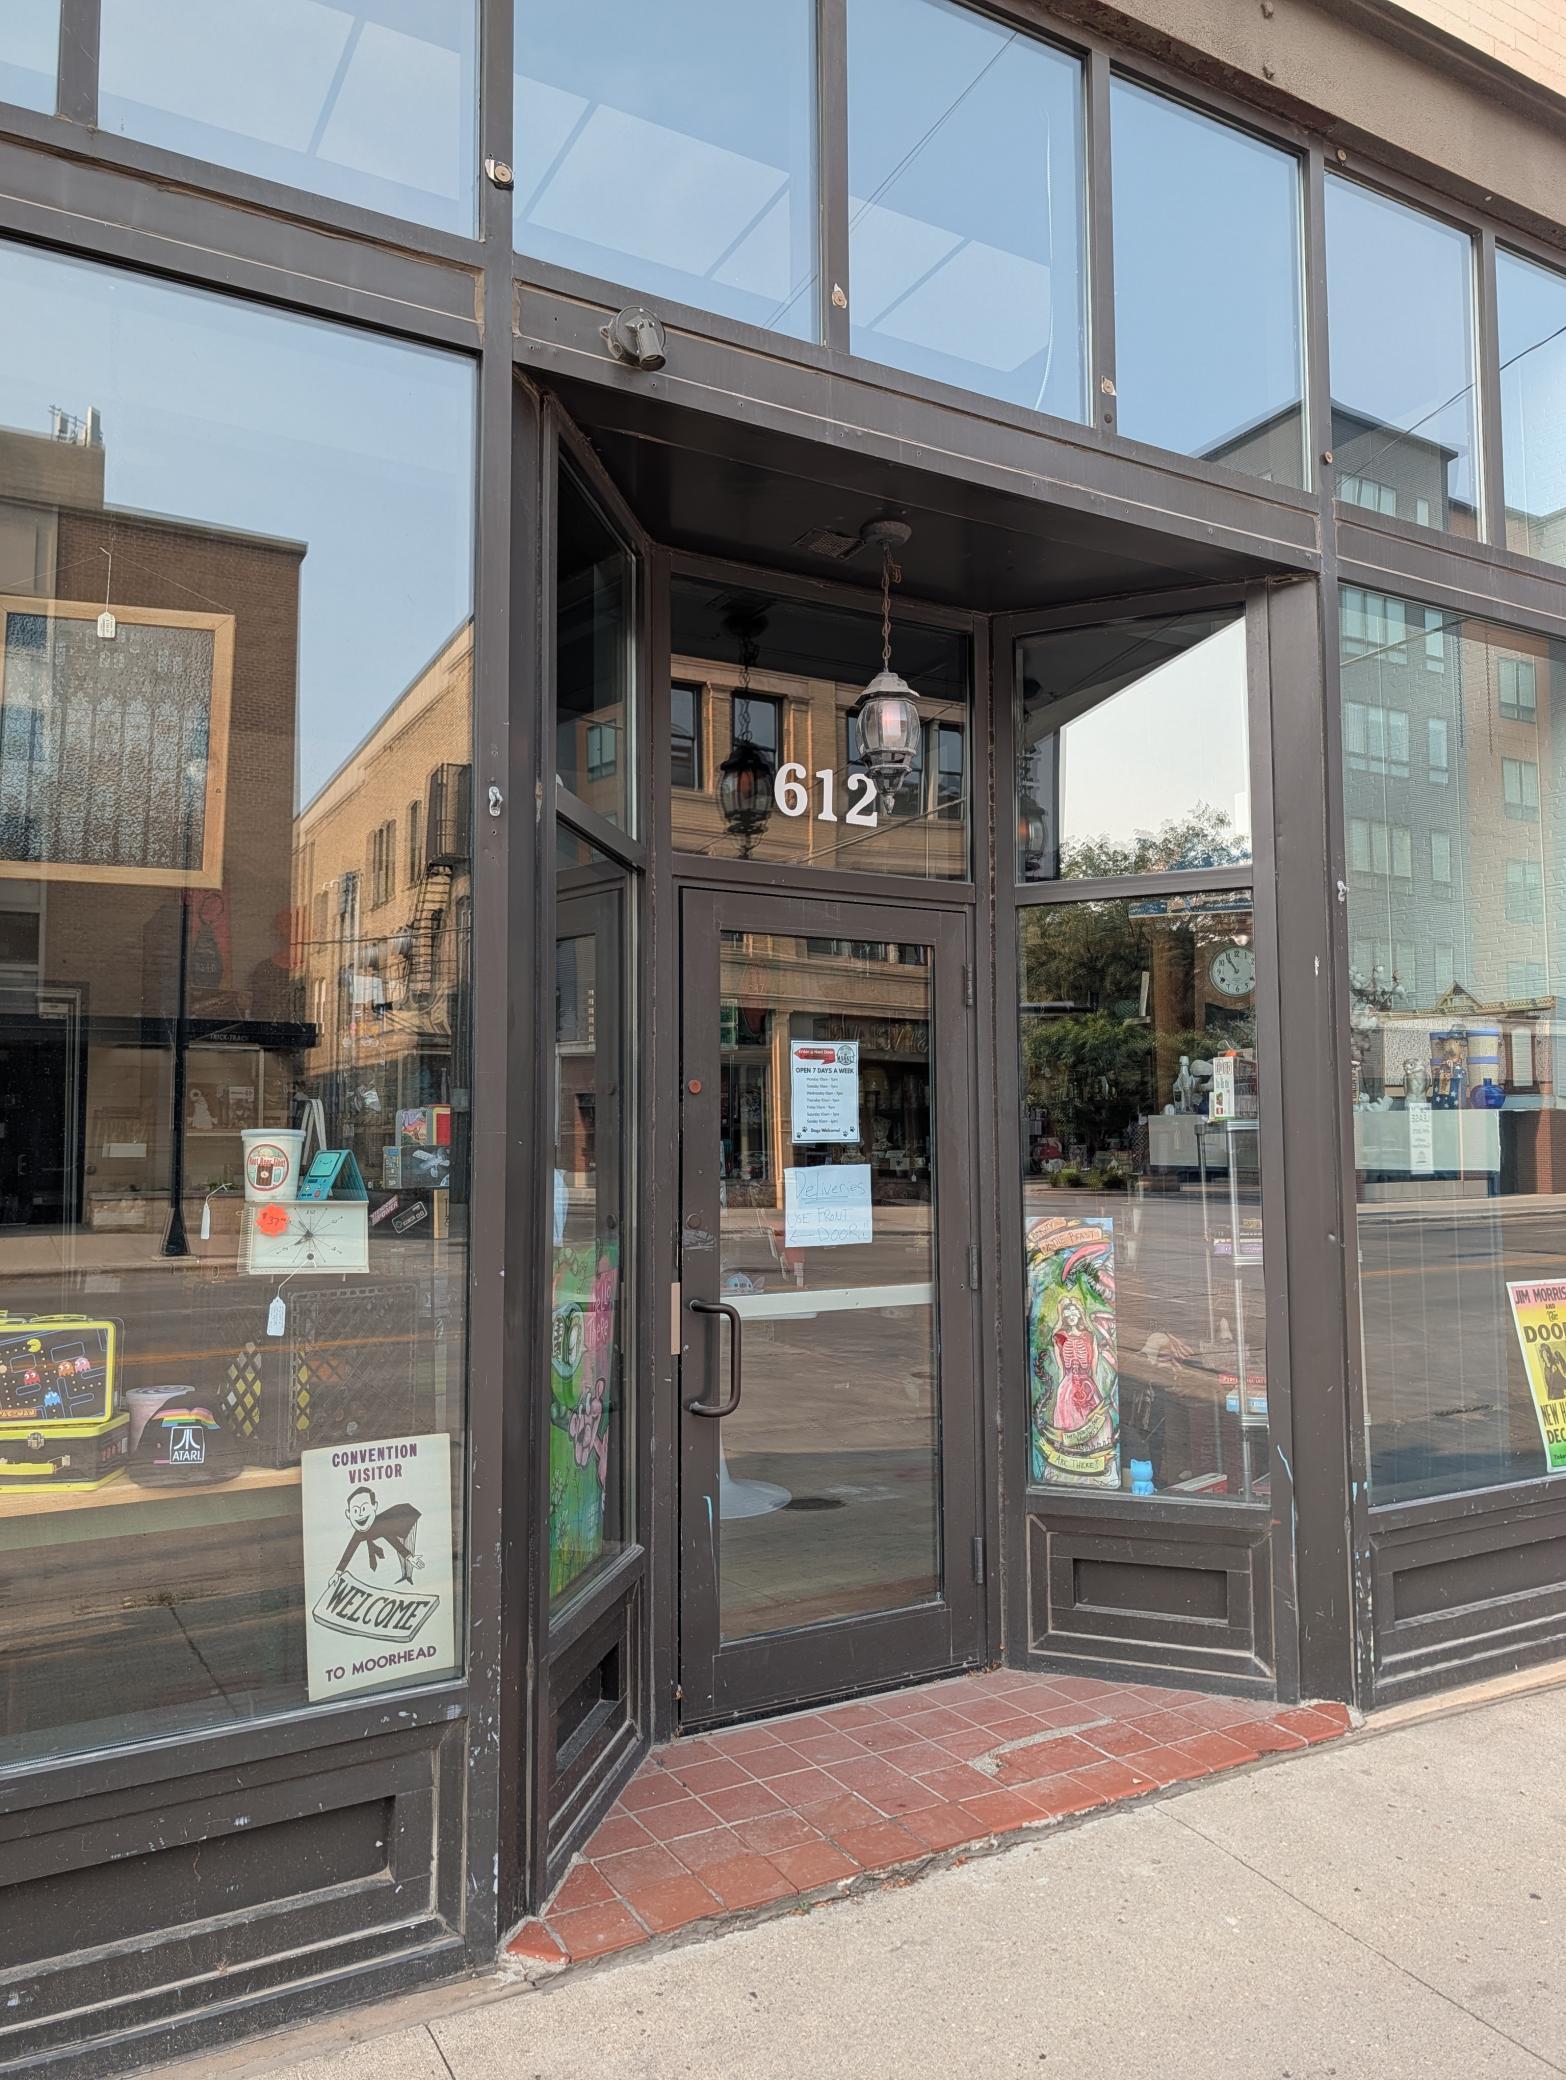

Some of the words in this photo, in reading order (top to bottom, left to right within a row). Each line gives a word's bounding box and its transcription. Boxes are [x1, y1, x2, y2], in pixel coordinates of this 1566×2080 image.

[774, 762, 878, 827] 612
[795, 1170, 866, 1199] Deliveries
[1515, 1289, 1531, 1304] JIM
[1541, 1403, 1559, 1427] NEW
[332, 1443, 417, 1467] CONVENTION
[349, 1464, 402, 1484] VISITOR
[325, 1577, 430, 1630] WELCOME
[325, 1666, 346, 1682] TO
[352, 1645, 437, 1676] MOORHEAD
